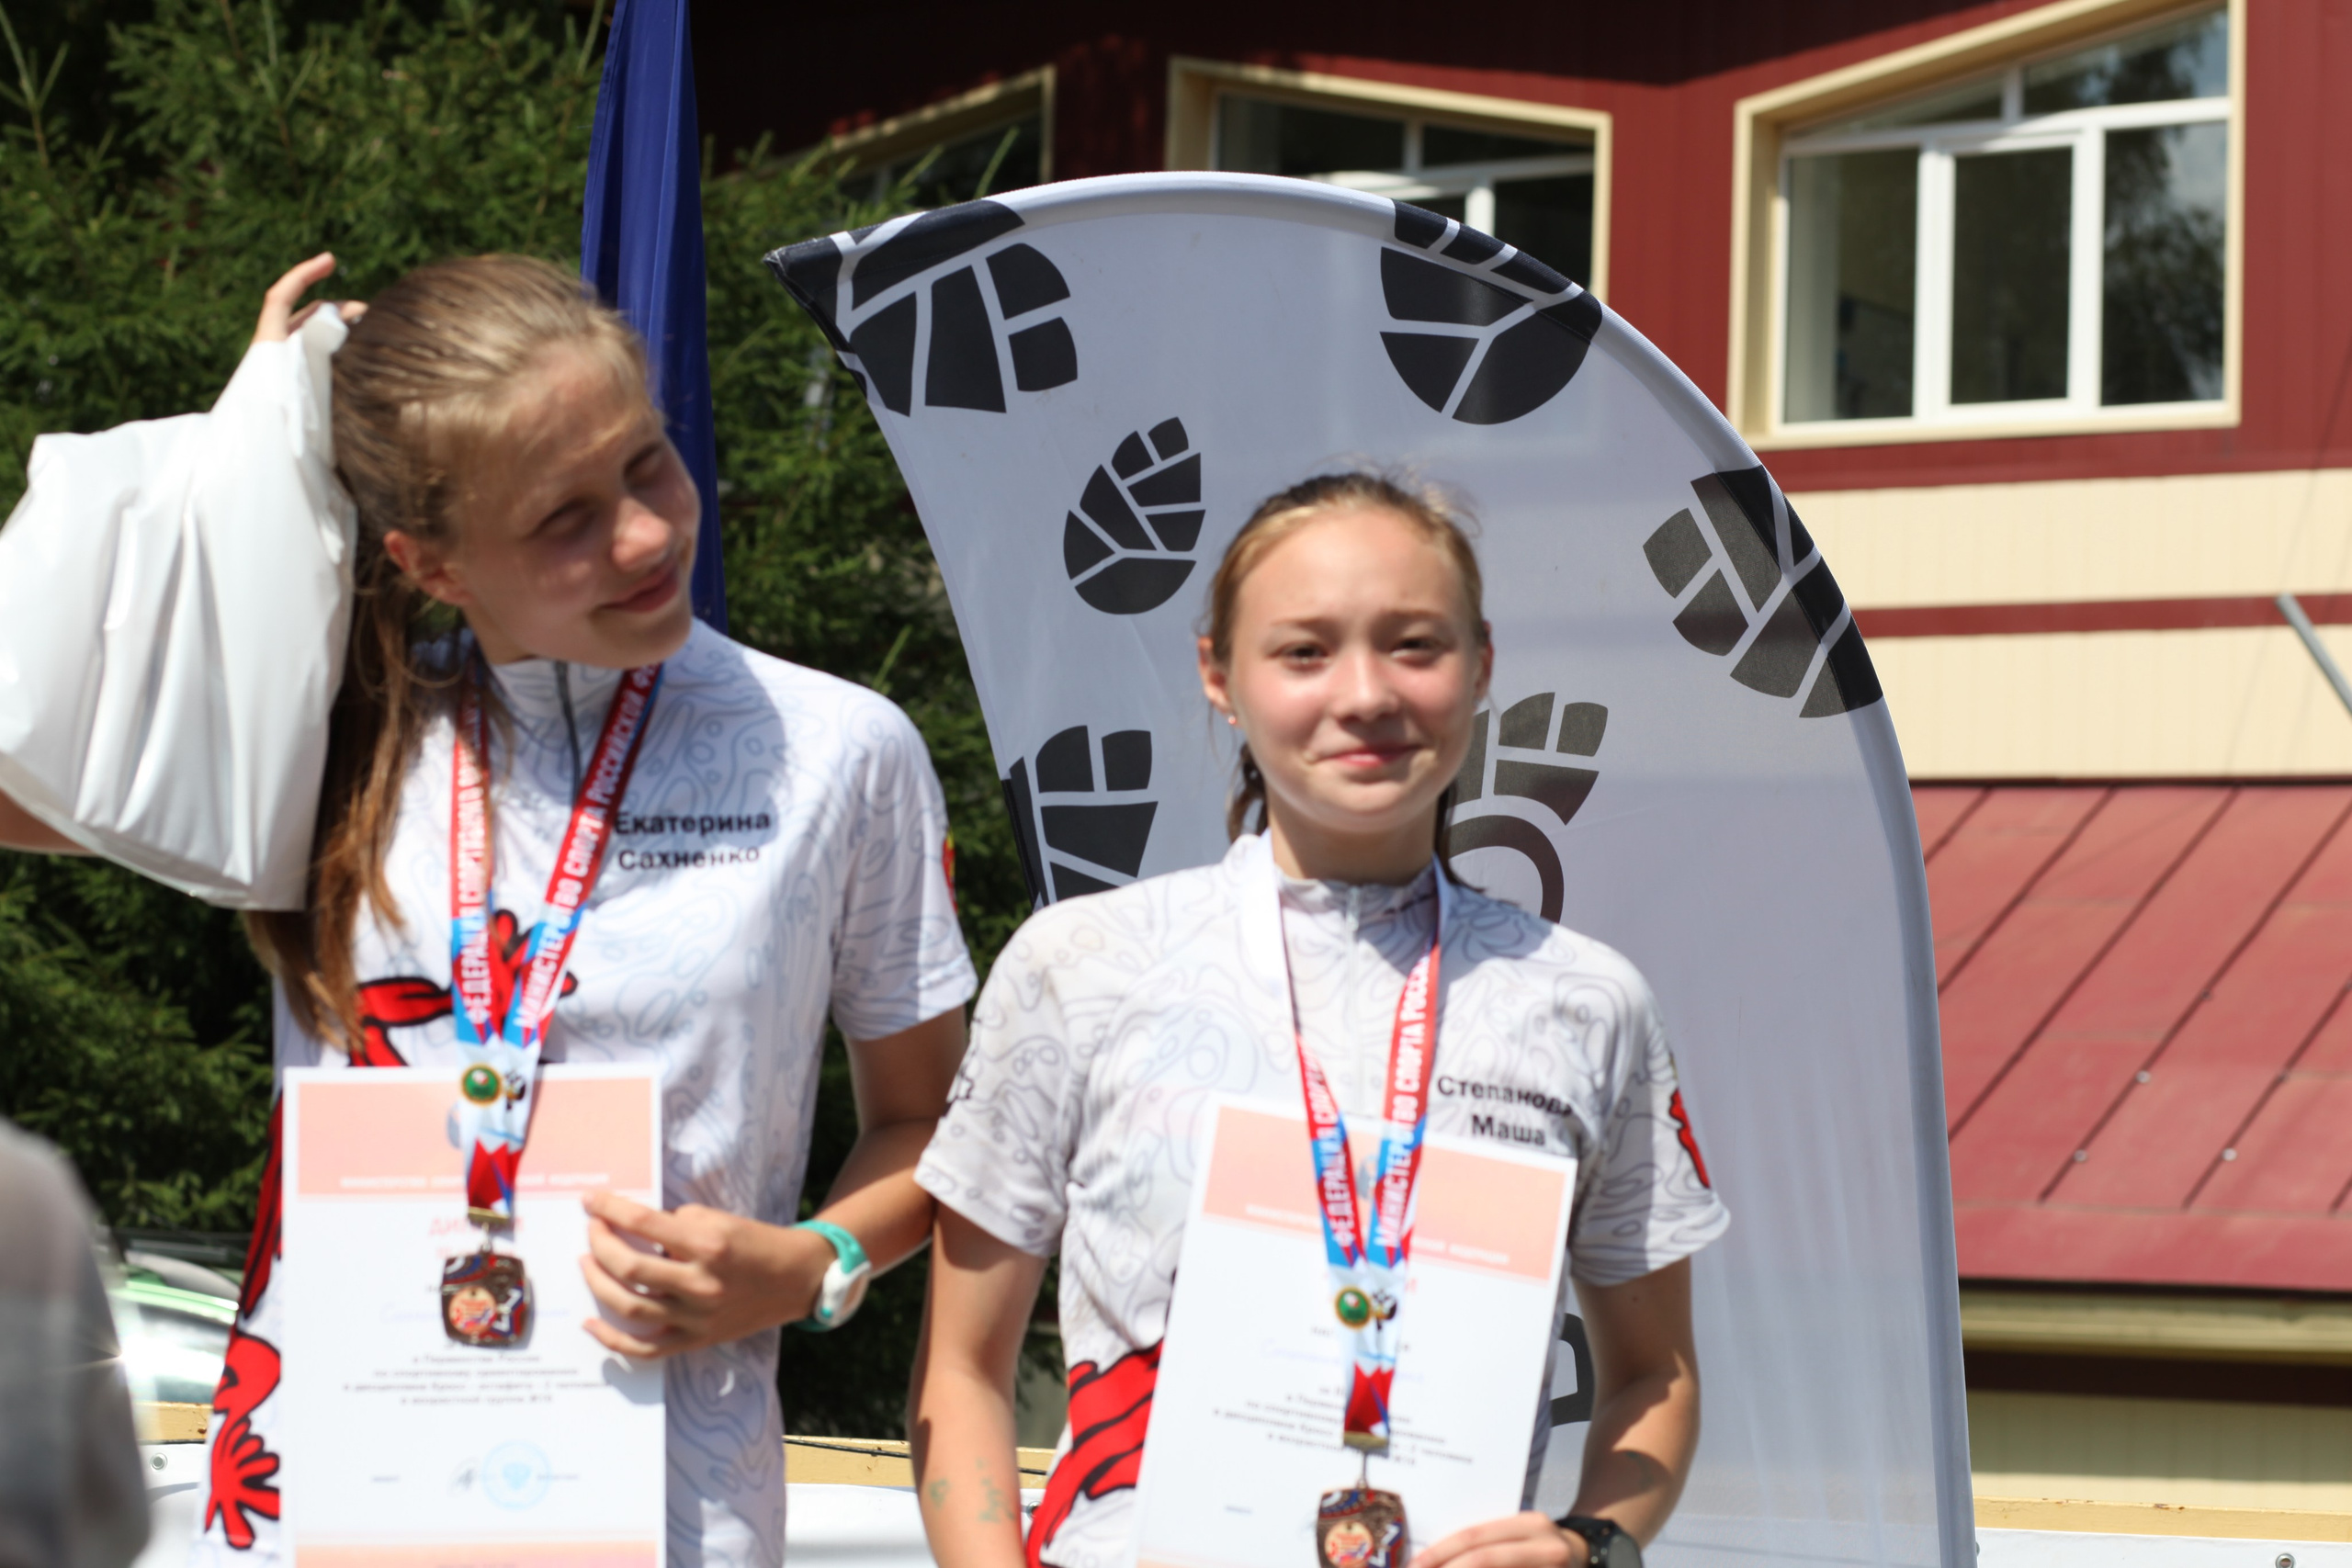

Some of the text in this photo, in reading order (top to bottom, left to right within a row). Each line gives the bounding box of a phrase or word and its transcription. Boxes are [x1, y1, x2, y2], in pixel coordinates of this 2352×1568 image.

[561, 801, 608, 878] СПОРТА
[615, 812, 770, 837] Екатерина
[618, 847, 760, 871] Сахненко
[1395, 1020, 1425, 1092] СПОРТА
[1472, 1114, 1546, 1146] Маша
